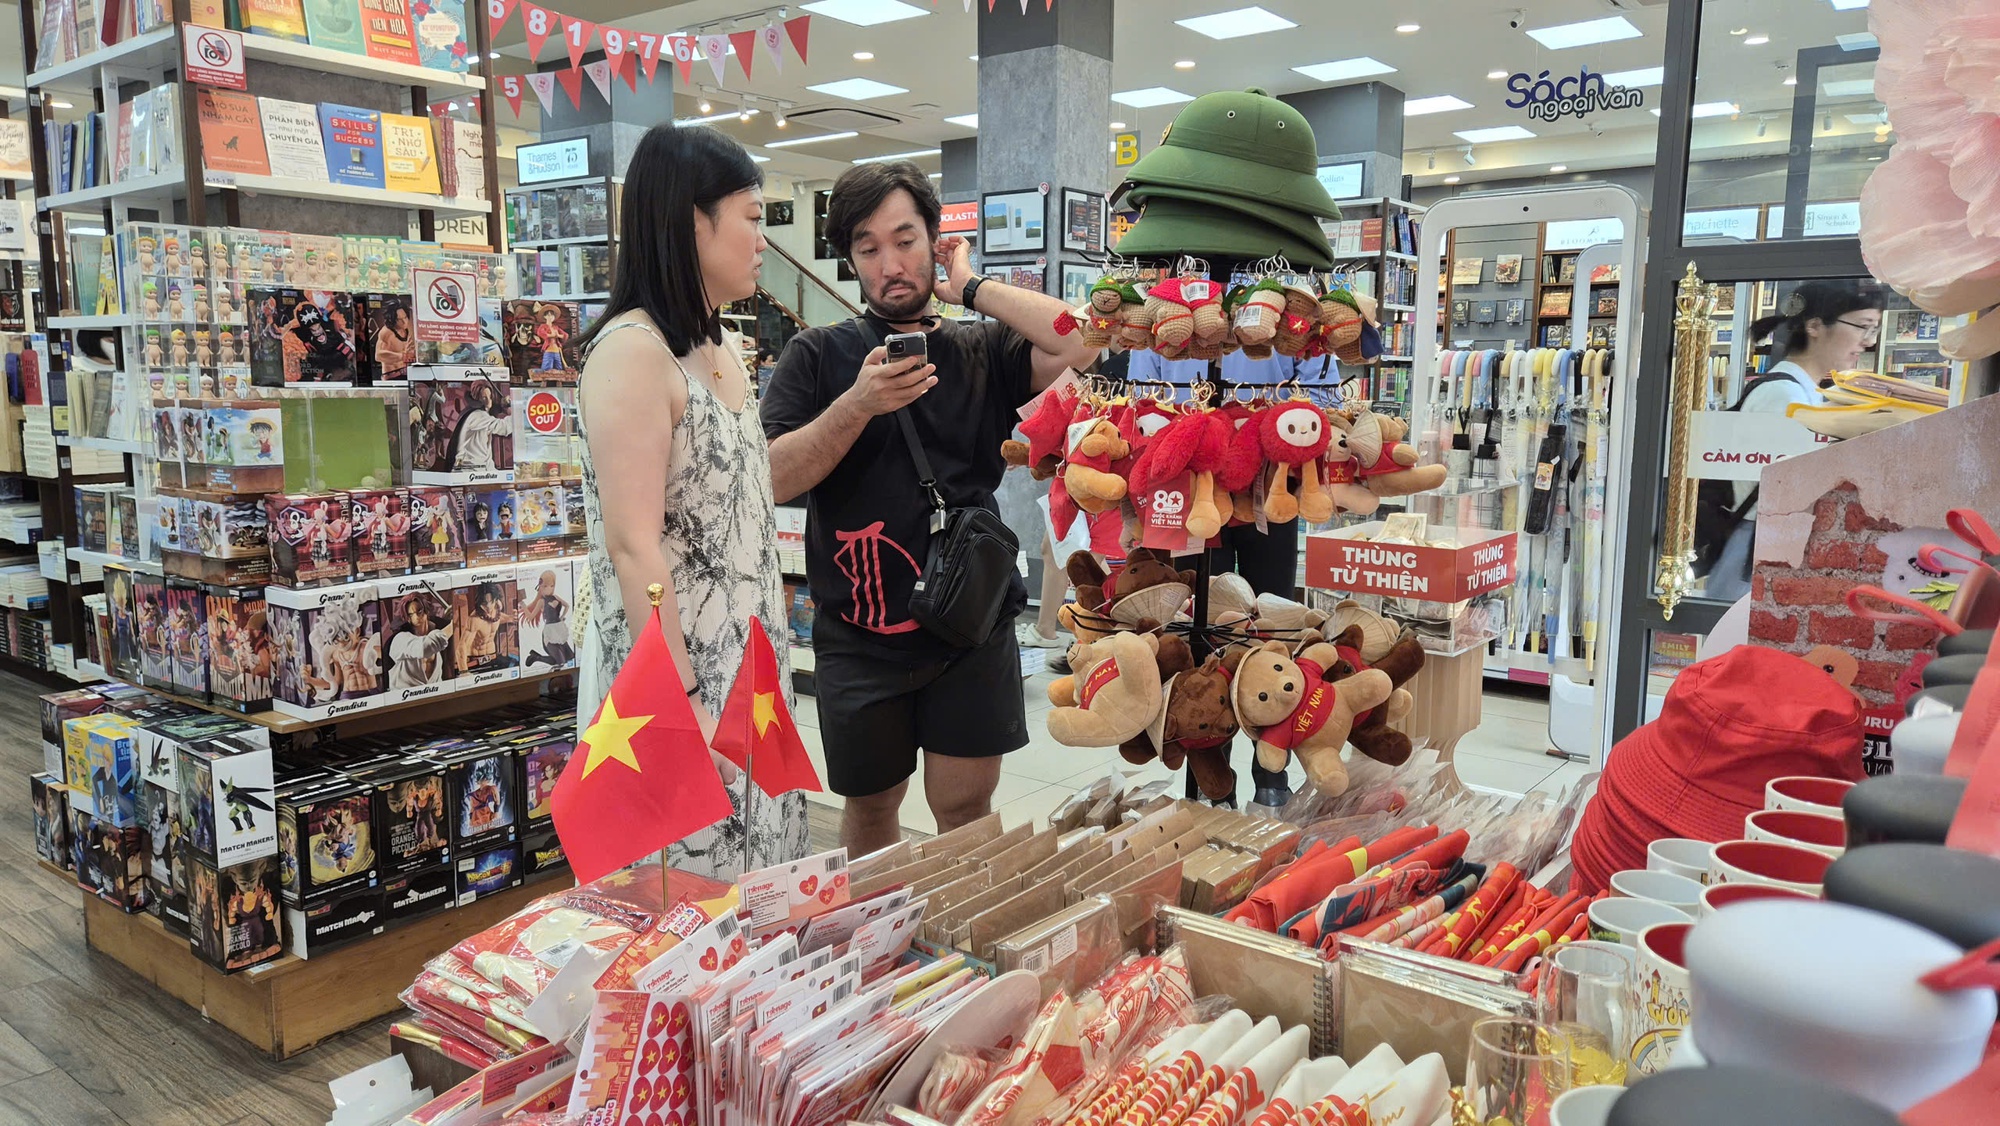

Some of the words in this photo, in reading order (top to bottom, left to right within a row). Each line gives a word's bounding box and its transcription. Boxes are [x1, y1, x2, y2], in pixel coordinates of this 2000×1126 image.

[529, 10, 546, 36] 8
[568, 21, 580, 46] 1
[606, 30, 622, 54] 9
[641, 36, 656, 58] 7
[675, 38, 691, 62] 6
[504, 78, 519, 97] 5
[1506, 65, 1604, 108] Sách
[1529, 90, 1595, 121] ngoại
[1598, 86, 1643, 109] văn
[332, 118, 373, 131] SKILLS
[305, 137, 319, 145] GIA
[335, 135, 374, 145] SUCCESS
[527, 152, 557, 163] Thames
[1116, 134, 1138, 166] B
[530, 403, 560, 417] SOLD
[535, 414, 555, 425] OUT
[1703, 448, 1740, 463] CẢM
[1745, 452, 1771, 464] ƠN
[469, 473, 498, 482] Grandista
[1342, 545, 1417, 569] THÙNG
[1473, 544, 1504, 567] THÙNG
[471, 574, 498, 582] Grandista
[1330, 564, 1360, 584] TỪ
[1362, 570, 1429, 595] THIỆN
[1467, 569, 1483, 591] TỪ
[1483, 564, 1507, 586] THIỆN
[1662, 642, 1690, 651] EMILY
[1657, 656, 1680, 666] Great
[474, 672, 503, 684] Grandista
[402, 686, 439, 701] Grandista
[327, 700, 368, 717] Grandista
[1296, 708, 1314, 734] VIỆT
[1309, 687, 1324, 708] NAM
[220, 843, 245, 853] MATCH
[246, 836, 274, 847] MAKERS
[391, 832, 416, 846] ORANGE
[392, 841, 416, 855] PICCOLO
[419, 886, 447, 900] MAKERS
[316, 921, 344, 936] MATCH
[681, 914, 701, 937] DECOR
